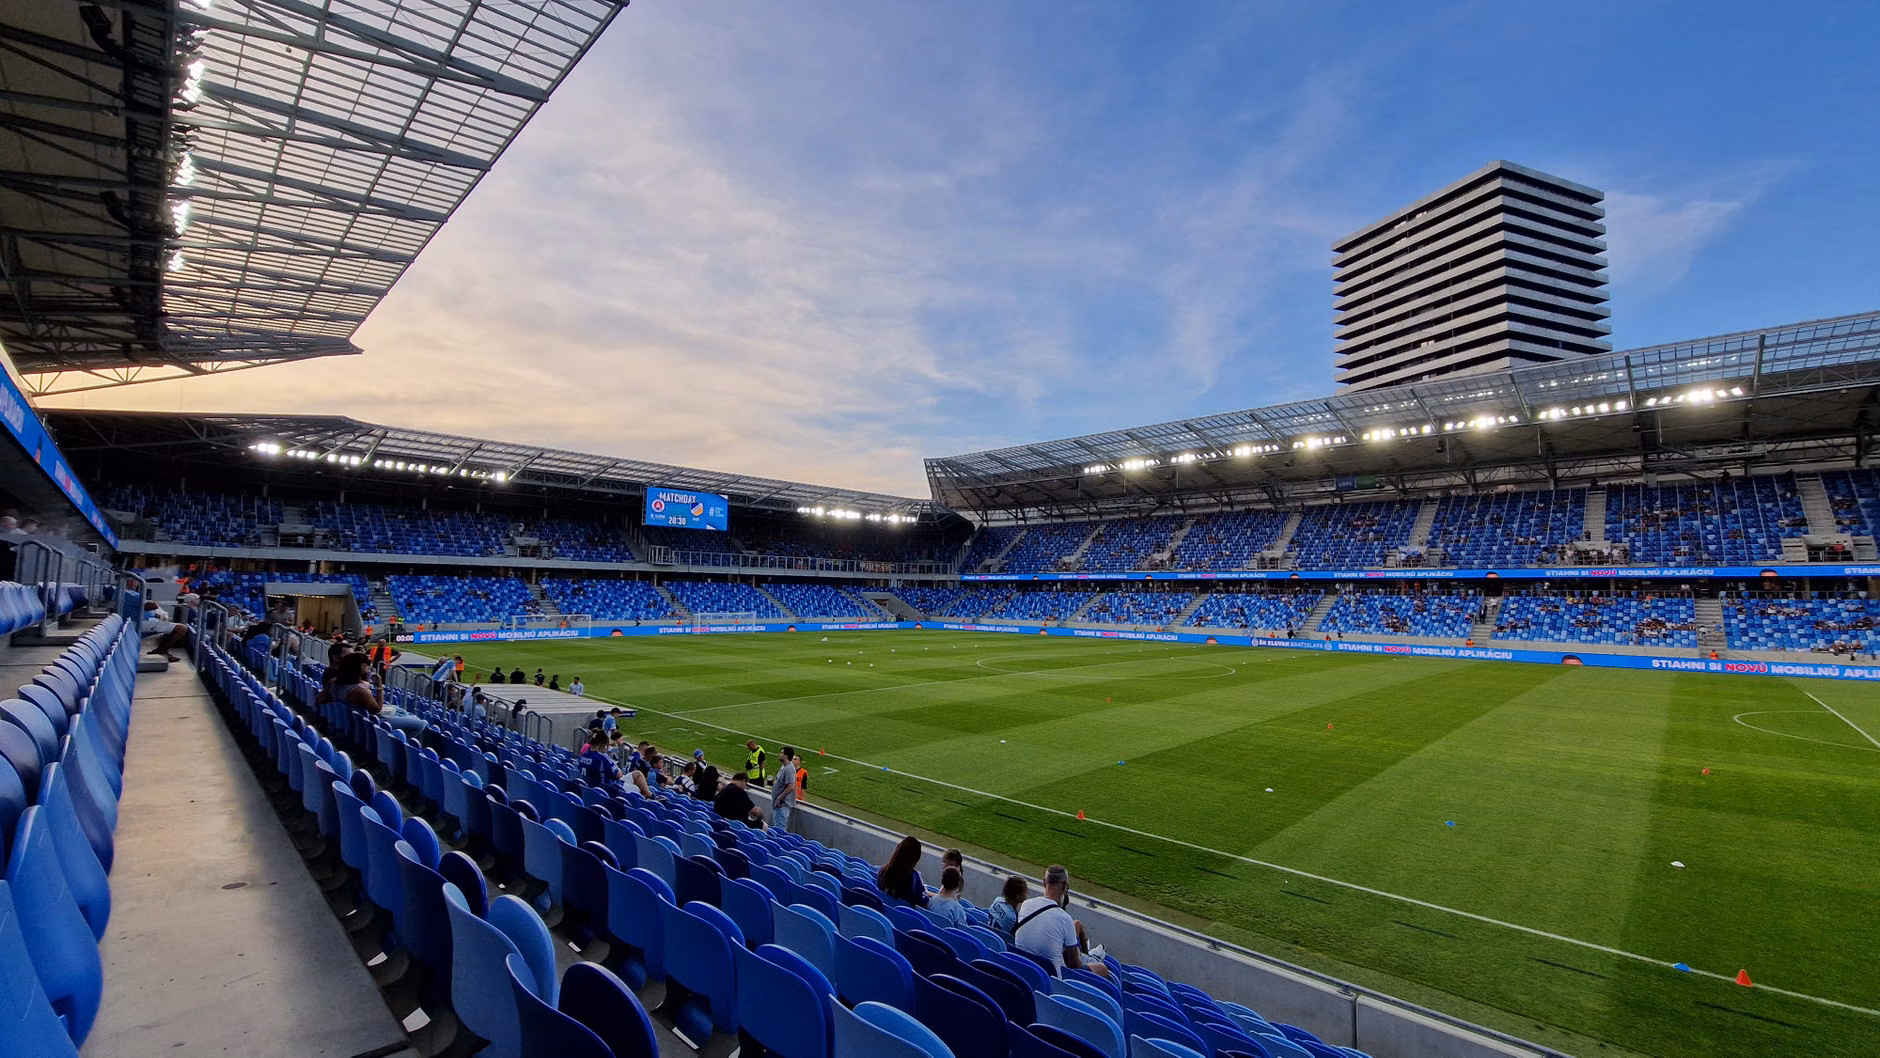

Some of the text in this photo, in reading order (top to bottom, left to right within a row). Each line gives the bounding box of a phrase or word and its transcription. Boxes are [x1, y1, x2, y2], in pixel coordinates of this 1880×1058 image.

[658, 492, 697, 504] MATCHDAY
[1844, 567, 1880, 575] STIAH
[420, 633, 458, 641] STIAHNI
[498, 629, 536, 639] MOBILNÚ
[1338, 643, 1373, 652] STIAHNI
[1413, 647, 1456, 656] MOBILNÚ
[1458, 649, 1512, 659] APLIKÁCIU
[1652, 659, 1880, 678] STIAHNI SI NOVÚ MOBILNÚ APLI
